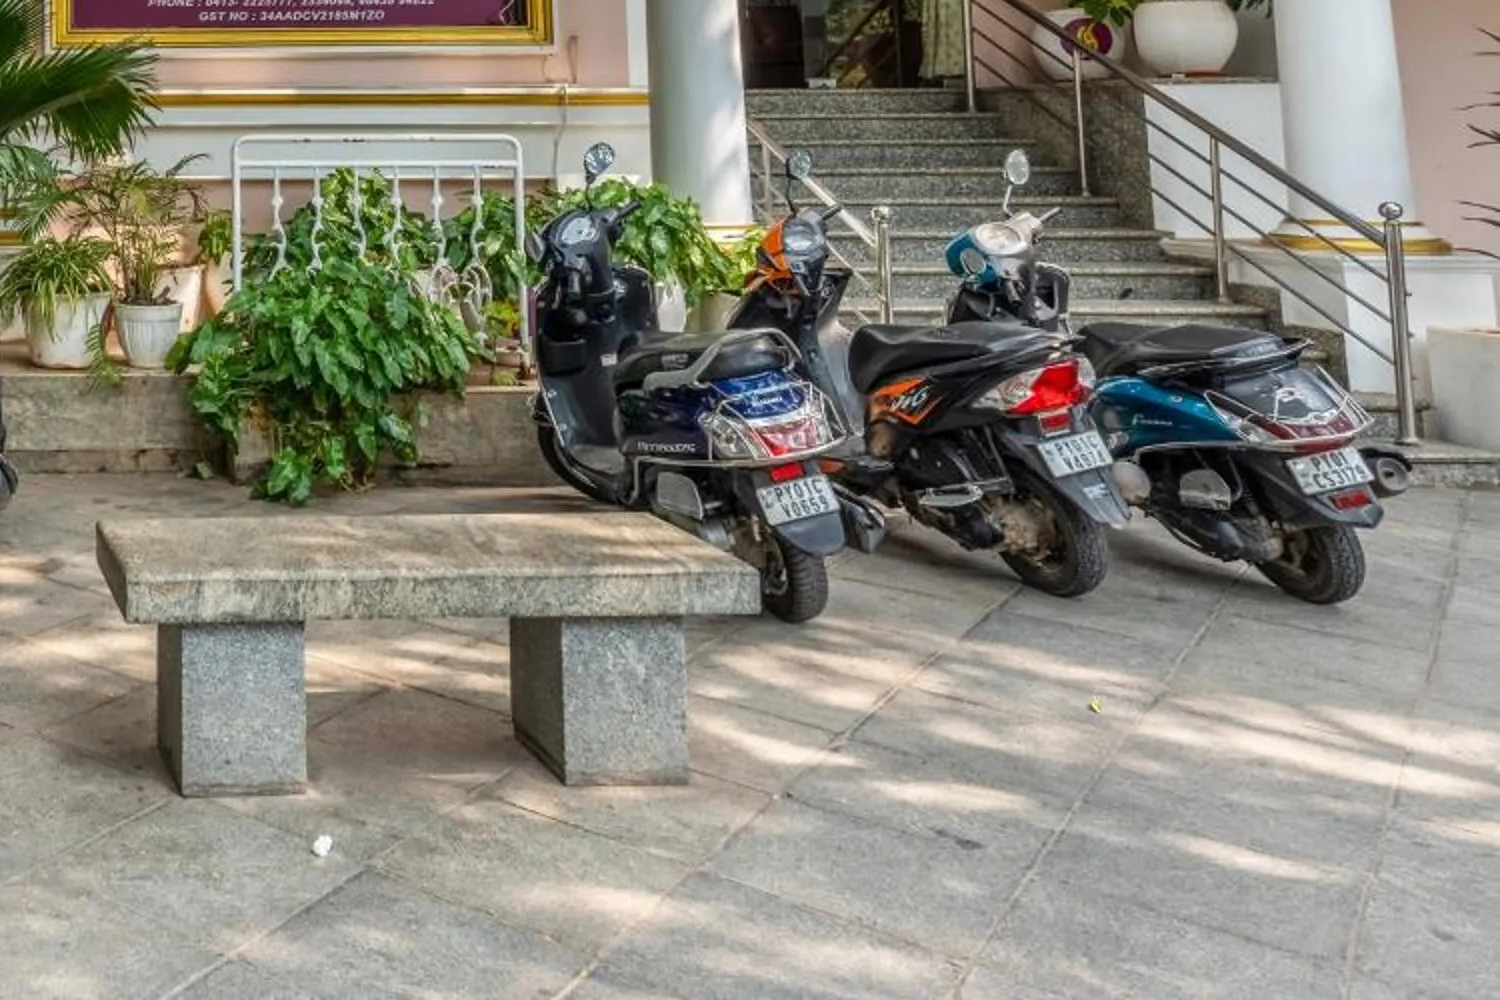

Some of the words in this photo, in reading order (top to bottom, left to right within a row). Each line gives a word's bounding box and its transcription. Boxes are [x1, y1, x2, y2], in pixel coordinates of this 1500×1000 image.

[199, 12, 227, 21] GST
[229, 12, 249, 21] NO
[1311, 450, 1349, 472] PY01
[774, 479, 824, 501] PY01C
